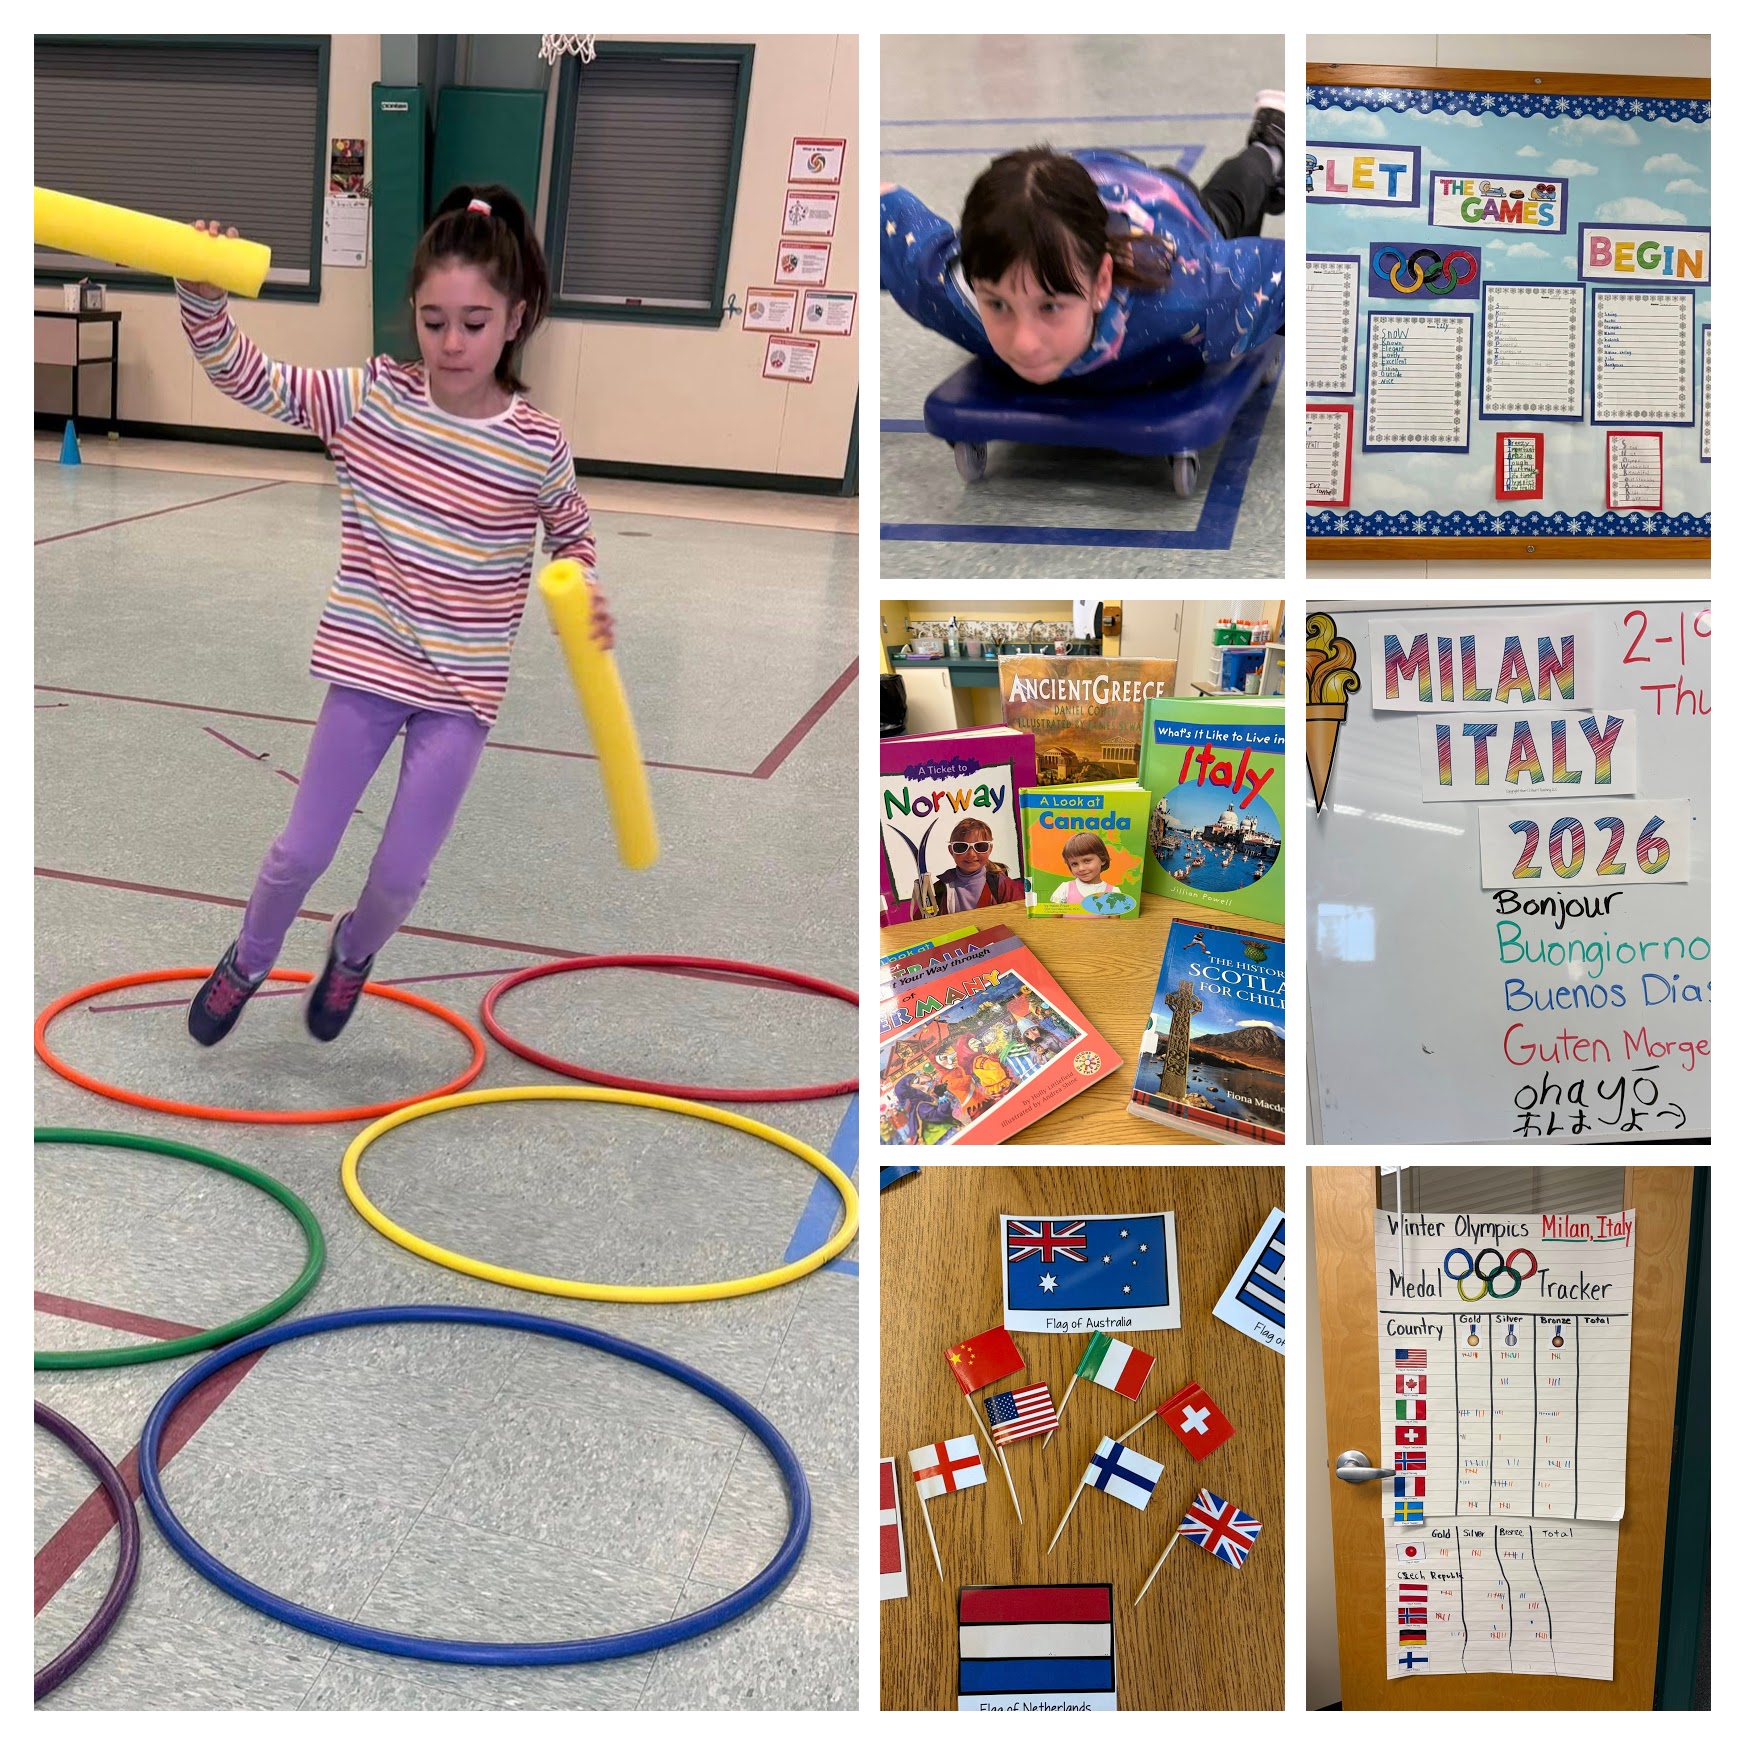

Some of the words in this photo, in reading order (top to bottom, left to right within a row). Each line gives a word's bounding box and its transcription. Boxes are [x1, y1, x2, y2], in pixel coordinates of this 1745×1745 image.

[1325, 156, 1407, 198] LET
[1440, 179, 1475, 196] THE
[1460, 196, 1554, 227] GAMES
[1590, 236, 1703, 278] BEGIN
[1384, 633, 1575, 703] MILAN
[1054, 705, 1084, 716] DANIEL
[1018, 718, 1072, 729] ILLUSTRATED
[1075, 719, 1085, 730] BY
[1086, 720, 1116, 731] JAMES
[1158, 727, 1192, 739] What's
[1194, 730, 1204, 739] It
[1206, 731, 1228, 741] Like
[1232, 732, 1242, 742] to
[1246, 733, 1270, 744] Live
[1274, 734, 1285, 744] in
[1436, 715, 1624, 786] ITALY
[918, 767, 926, 776] A
[927, 765, 956, 774] Ticket
[1178, 742, 1274, 810] Italy
[884, 784, 1005, 819] Norway
[1040, 796, 1049, 806] A
[1053, 797, 1084, 806] Look
[1087, 797, 1100, 807] at
[1039, 811, 1131, 830] Canada
[1508, 815, 1670, 880] 2026
[1170, 886, 1198, 898] Jillian
[1202, 893, 1233, 906] Powell
[1493, 889, 1624, 930] Bonjour
[1496, 920, 1711, 978] Buongiorno
[900, 972, 924, 986] Your
[926, 964, 948, 976] Way
[951, 948, 990, 967] through
[1208, 956, 1233, 967] THE
[902, 993, 916, 1003] of
[1200, 982, 1232, 997] FOR
[1504, 978, 1626, 1012] Buenos
[1503, 1023, 1610, 1065] Guten
[1623, 1027, 1711, 1071] Morge
[1031, 1088, 1047, 1101] Holly
[1047, 1071, 1074, 1091] Littlefield
[1001, 1106, 1033, 1128] illustrated
[1042, 1088, 1062, 1103] Andrea
[1062, 1076, 1078, 1090] Shine
[1227, 1090, 1252, 1104] Fiona
[1387, 1214, 1445, 1237] Winter
[1455, 1215, 1529, 1247] Olympics
[1542, 1214, 1593, 1242] Milan,
[1596, 1212, 1632, 1247] Italy
[1389, 1268, 1442, 1298] Medal
[1538, 1268, 1613, 1300] Tracker
[1046, 1318, 1068, 1332] Flag
[1071, 1318, 1083, 1328] of
[1086, 1316, 1132, 1328] Australia
[1387, 1317, 1443, 1341] Country
[1460, 1315, 1481, 1324] Gold
[1495, 1315, 1523, 1323] Silver
[1540, 1316, 1571, 1324] Bronze
[1254, 1322, 1275, 1343] Flag
[1431, 1528, 1451, 1539] Gold
[1463, 1529, 1485, 1538] Silver
[1542, 1528, 1573, 1538] Total
